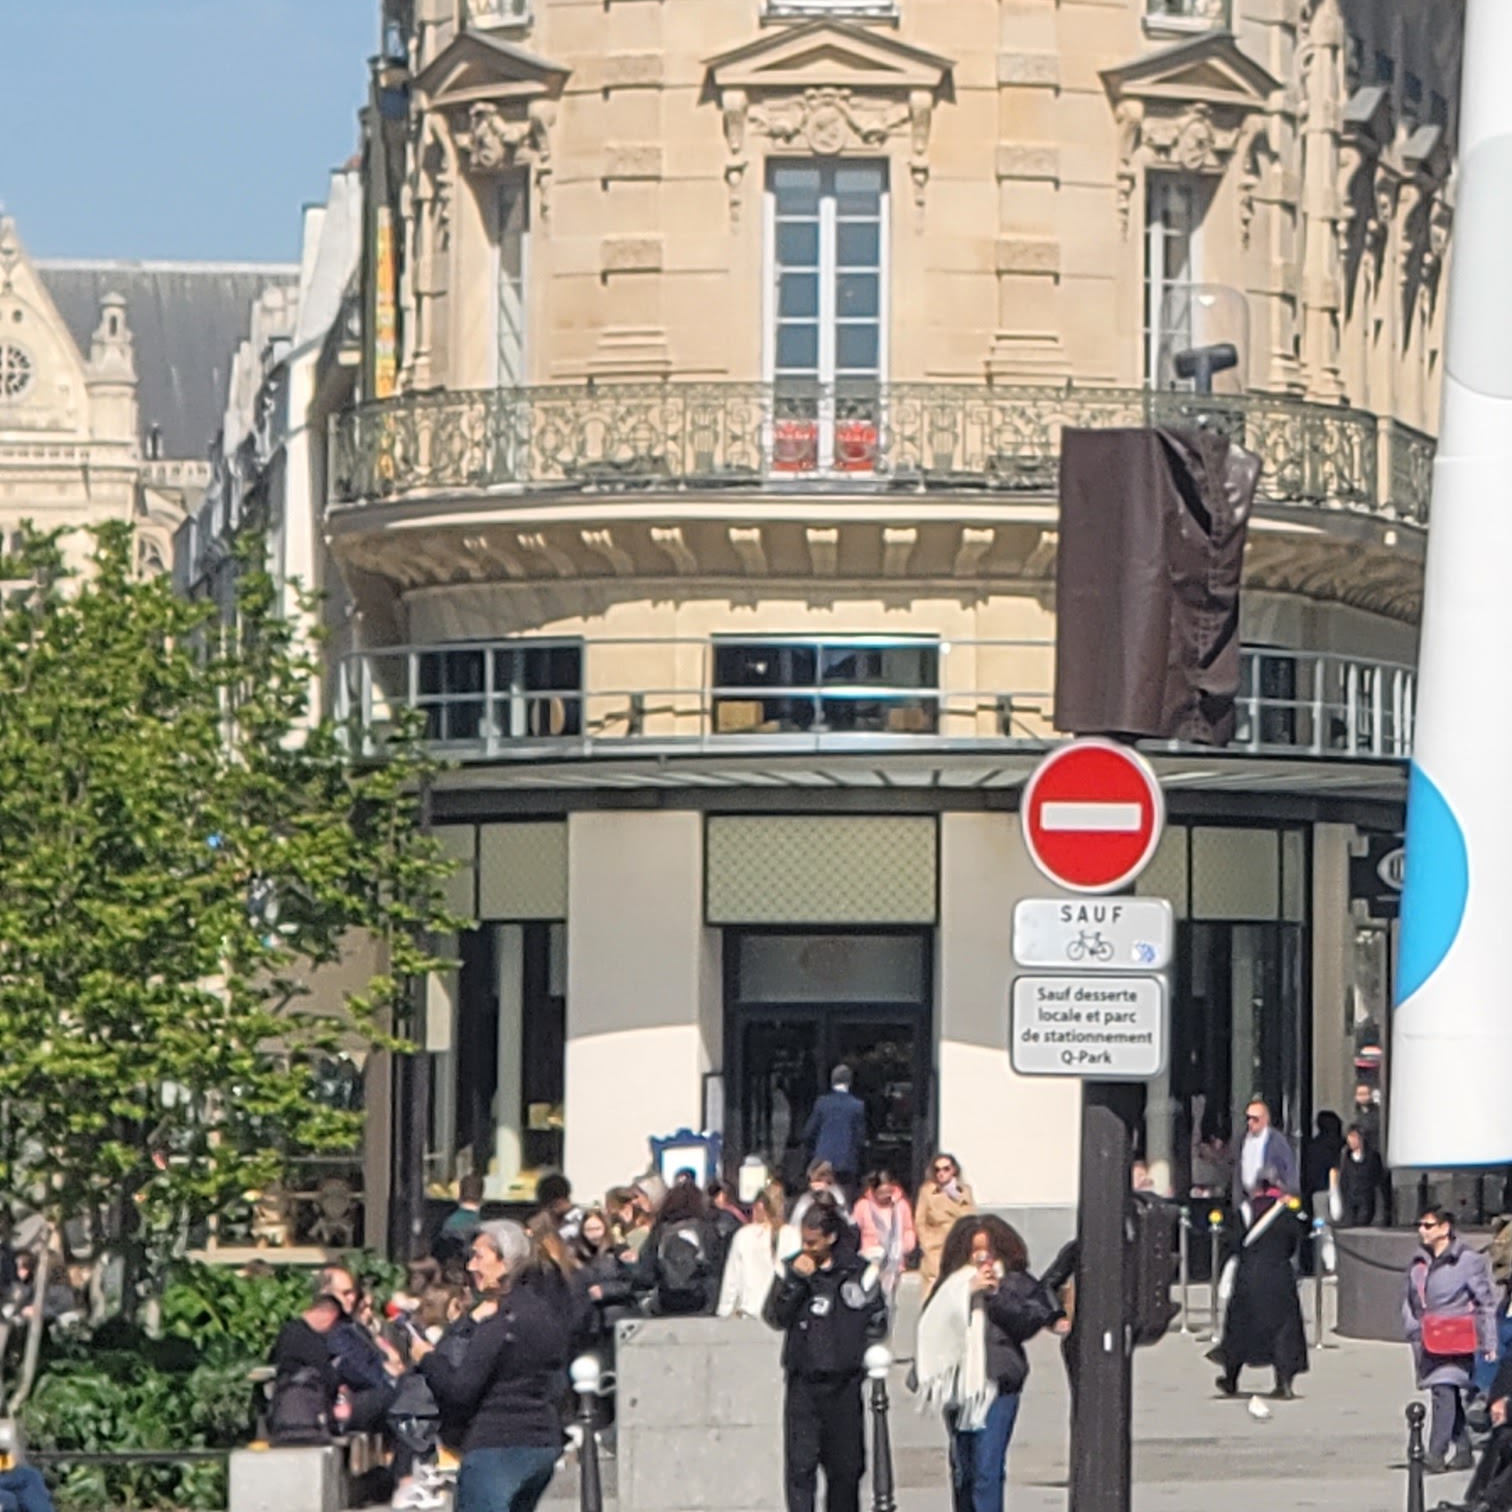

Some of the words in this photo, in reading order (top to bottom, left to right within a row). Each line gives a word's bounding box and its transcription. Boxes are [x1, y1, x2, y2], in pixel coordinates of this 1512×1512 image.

[1060, 904, 1123, 923] SAUF
[1037, 987, 1072, 1002] Sauf
[1074, 988, 1137, 1002] desserte
[1037, 1008, 1082, 1023] locale
[1086, 1009, 1101, 1023] et
[1103, 1011, 1137, 1026] parc
[1021, 1029, 1041, 1043] de
[1043, 1029, 1153, 1045] stationnement
[1060, 1050, 1112, 1066] Q-Park
